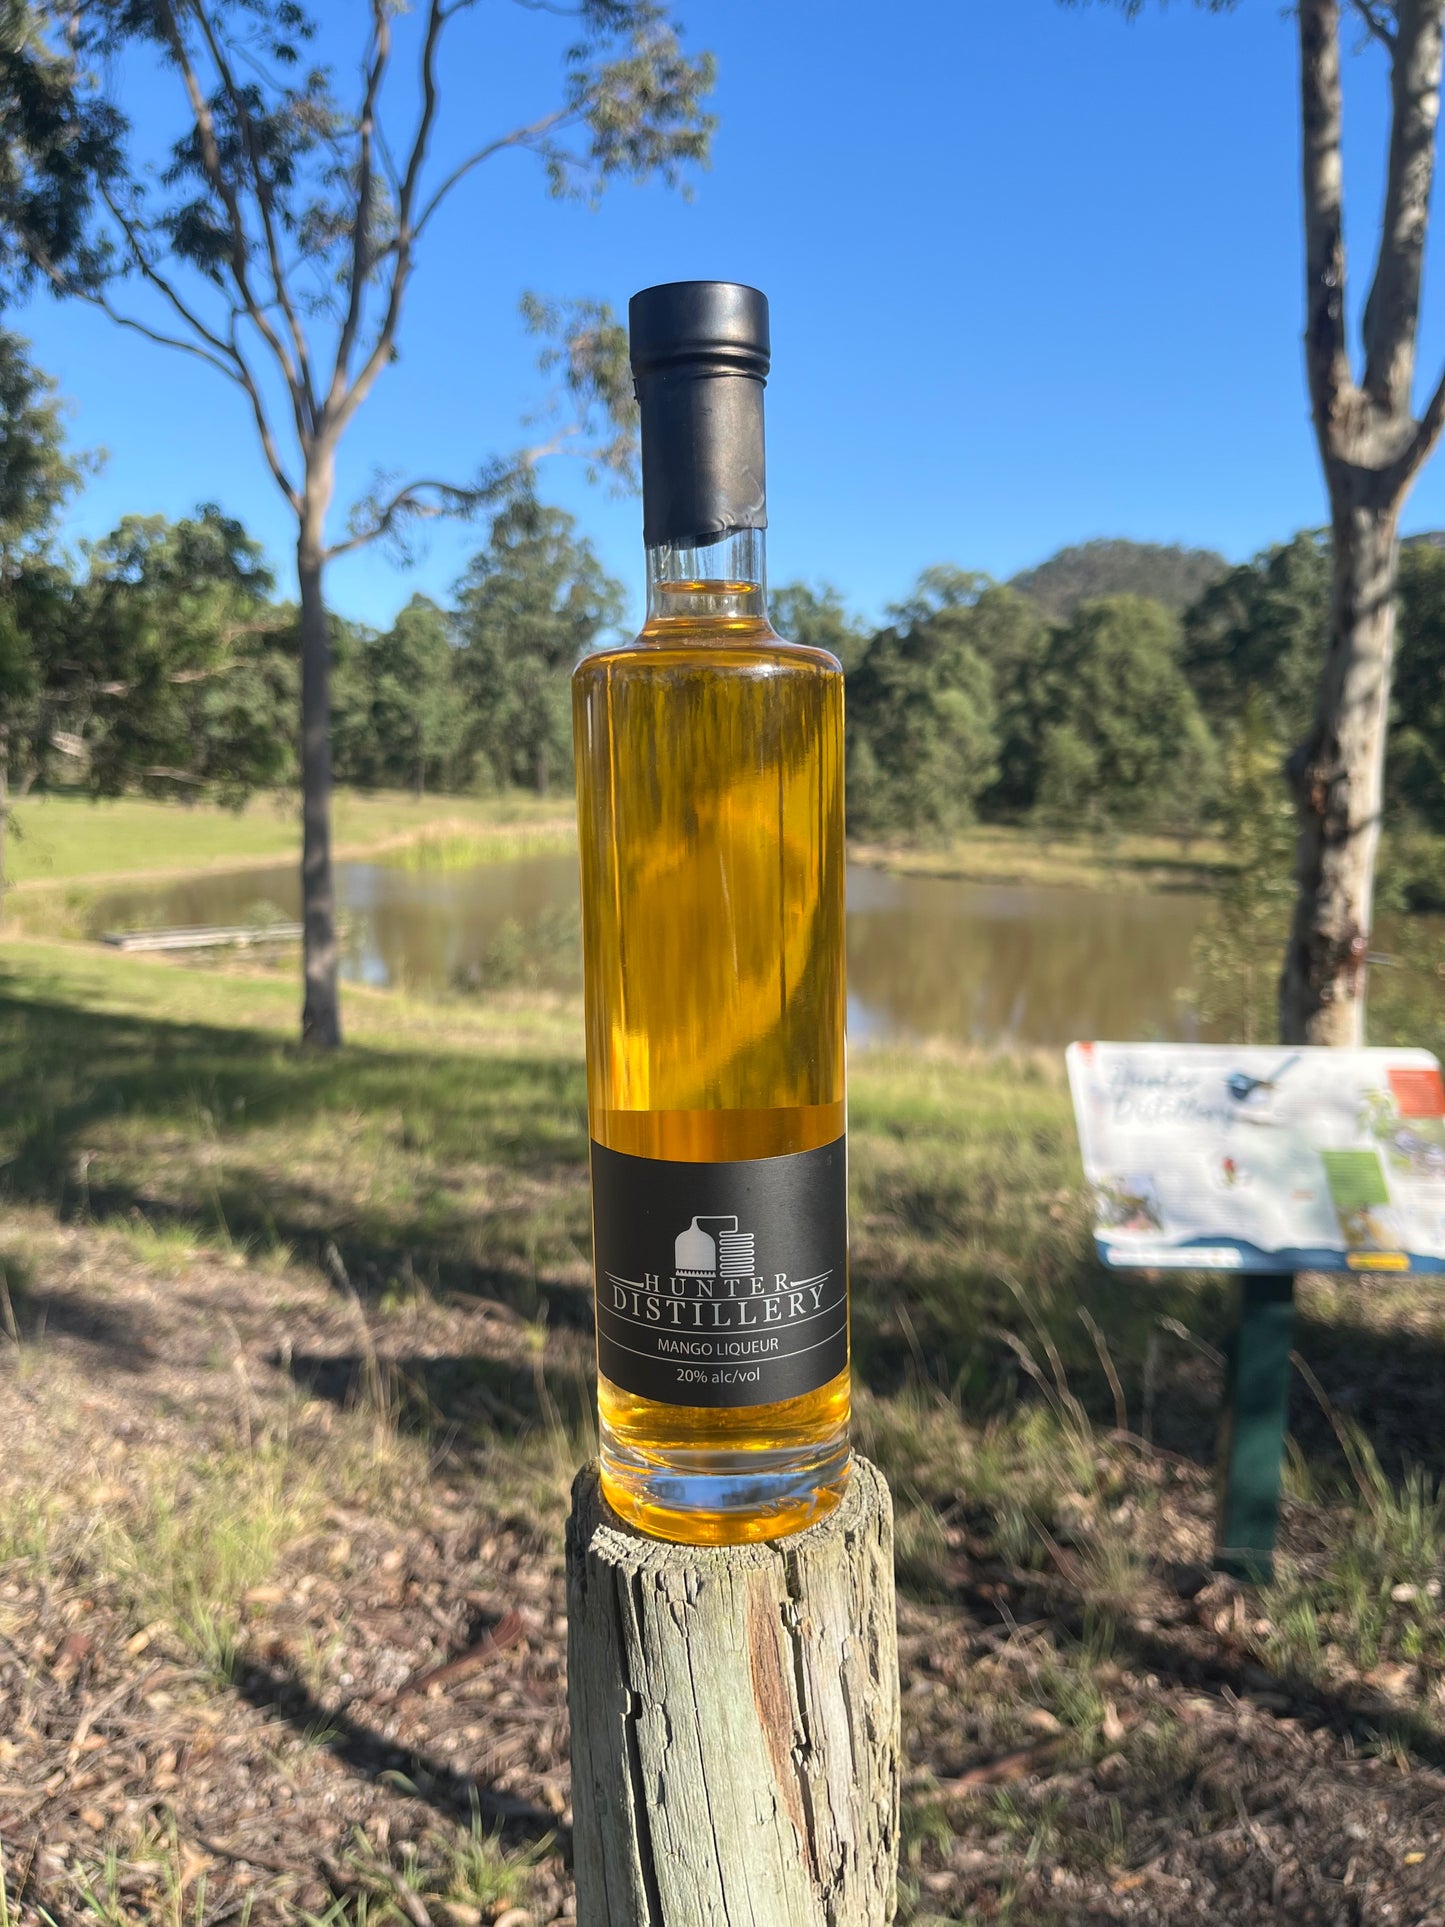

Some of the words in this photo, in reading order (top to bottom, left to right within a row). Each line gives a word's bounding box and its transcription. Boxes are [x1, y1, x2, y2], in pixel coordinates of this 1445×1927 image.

[644, 1273, 788, 1297] HUNTER
[613, 1284, 824, 1326] DISTILLERY
[658, 1338, 713, 1356] MANGO
[717, 1338, 779, 1356] LIQUEUR
[676, 1368, 708, 1383] 20%
[712, 1367, 760, 1384] alc/vol
